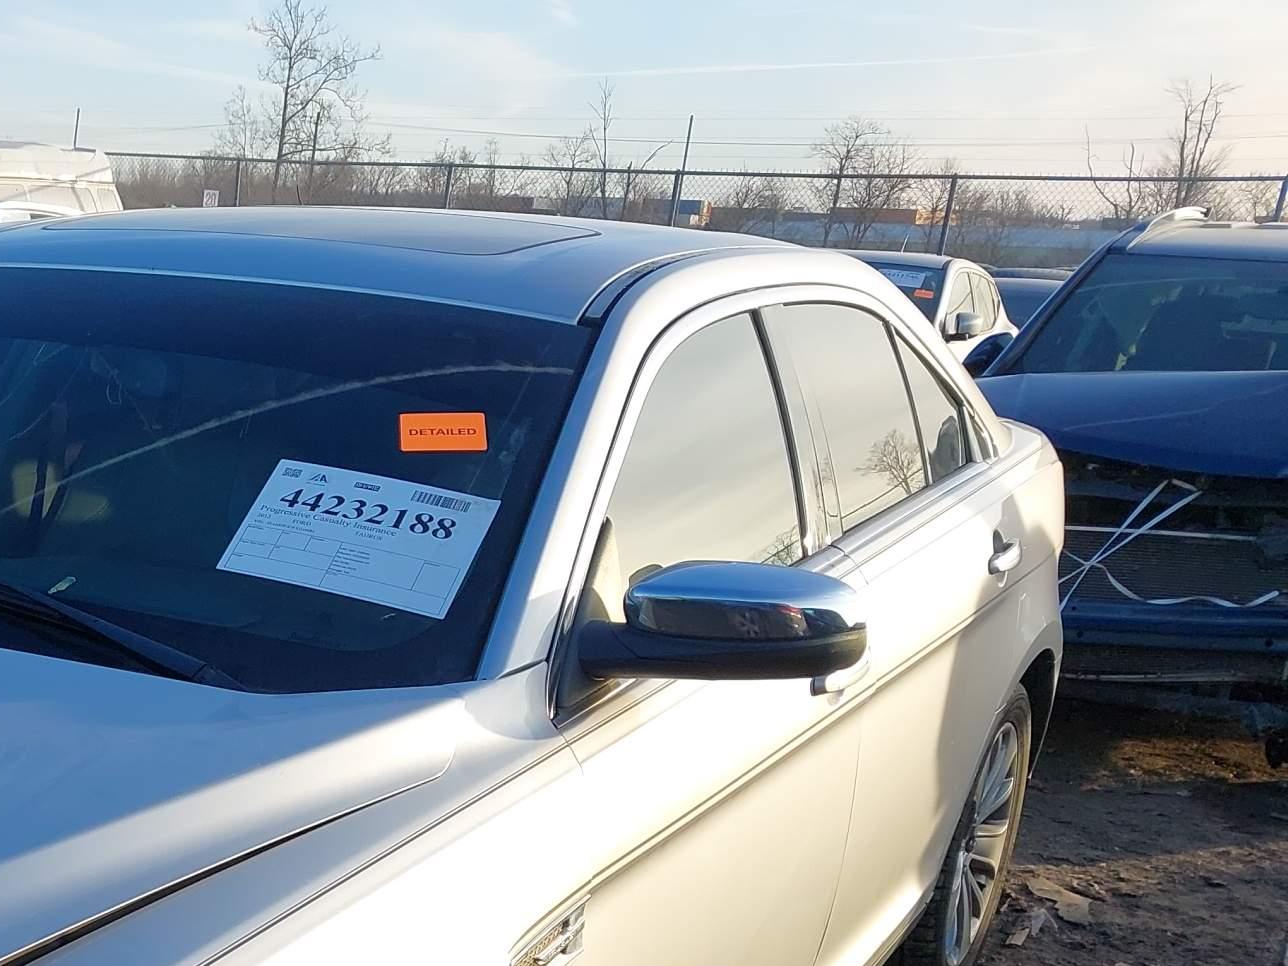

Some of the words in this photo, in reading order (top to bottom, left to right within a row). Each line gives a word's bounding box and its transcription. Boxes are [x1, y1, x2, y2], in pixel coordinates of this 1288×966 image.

[408, 427, 477, 436] DETAILED
[260, 504, 311, 520] Progressive
[312, 513, 352, 529] Casualty
[352, 521, 398, 537] Insurance
[279, 488, 457, 540] 44232188
